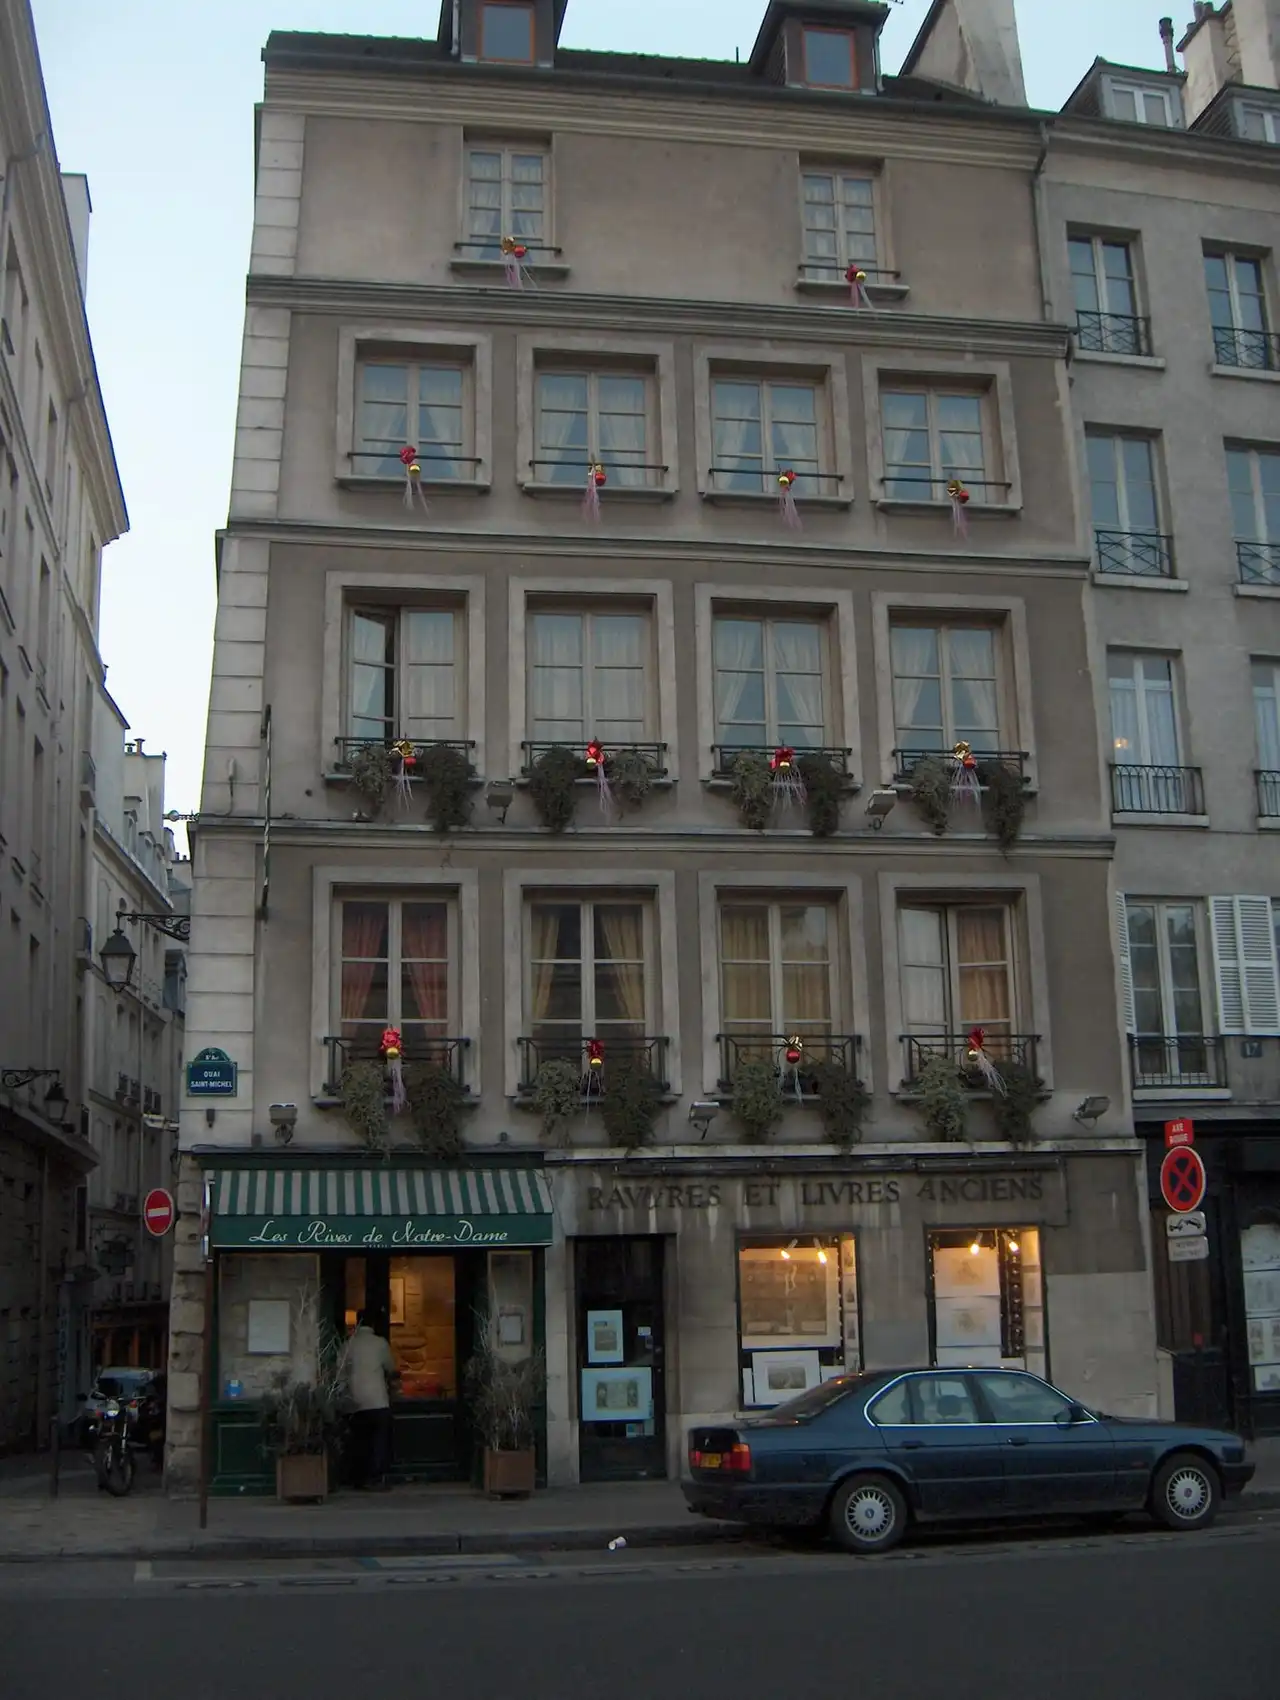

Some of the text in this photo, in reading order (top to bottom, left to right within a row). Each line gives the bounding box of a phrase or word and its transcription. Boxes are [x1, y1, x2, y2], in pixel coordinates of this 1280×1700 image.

[203, 1070, 220, 1078] QUAI
[190, 1080, 233, 1088] SAINT-MICHEL
[745, 1182, 780, 1207] ET
[801, 1180, 900, 1206] LIVRES
[916, 1177, 1043, 1202] ANCIENS
[248, 1220, 508, 1244] Les Rives de Notre-Dame
